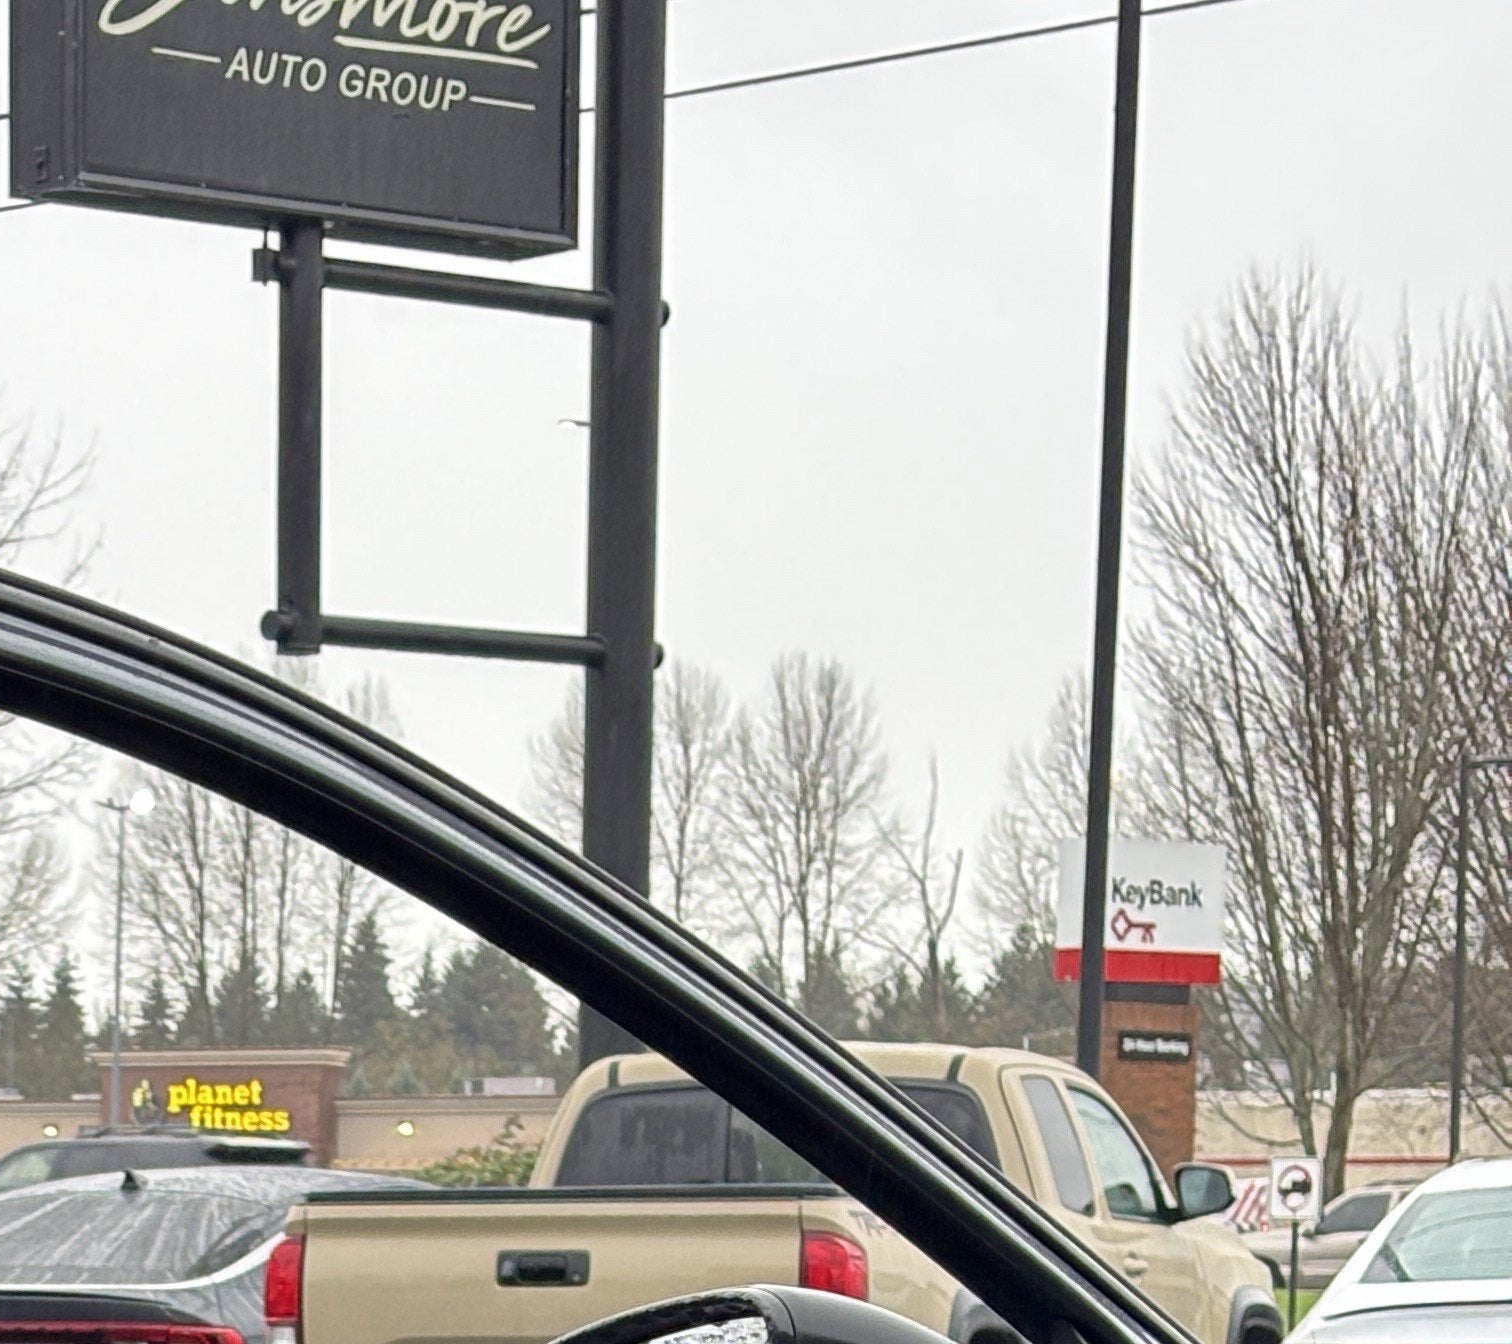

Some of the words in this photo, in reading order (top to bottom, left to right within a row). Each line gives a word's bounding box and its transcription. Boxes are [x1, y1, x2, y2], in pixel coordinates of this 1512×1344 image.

[225, 46, 327, 93] AUTO
[339, 64, 468, 111] GROUP
[1111, 876, 1203, 910] KeyBank
[167, 1078, 263, 1114] planet
[190, 1105, 291, 1131] fitness
